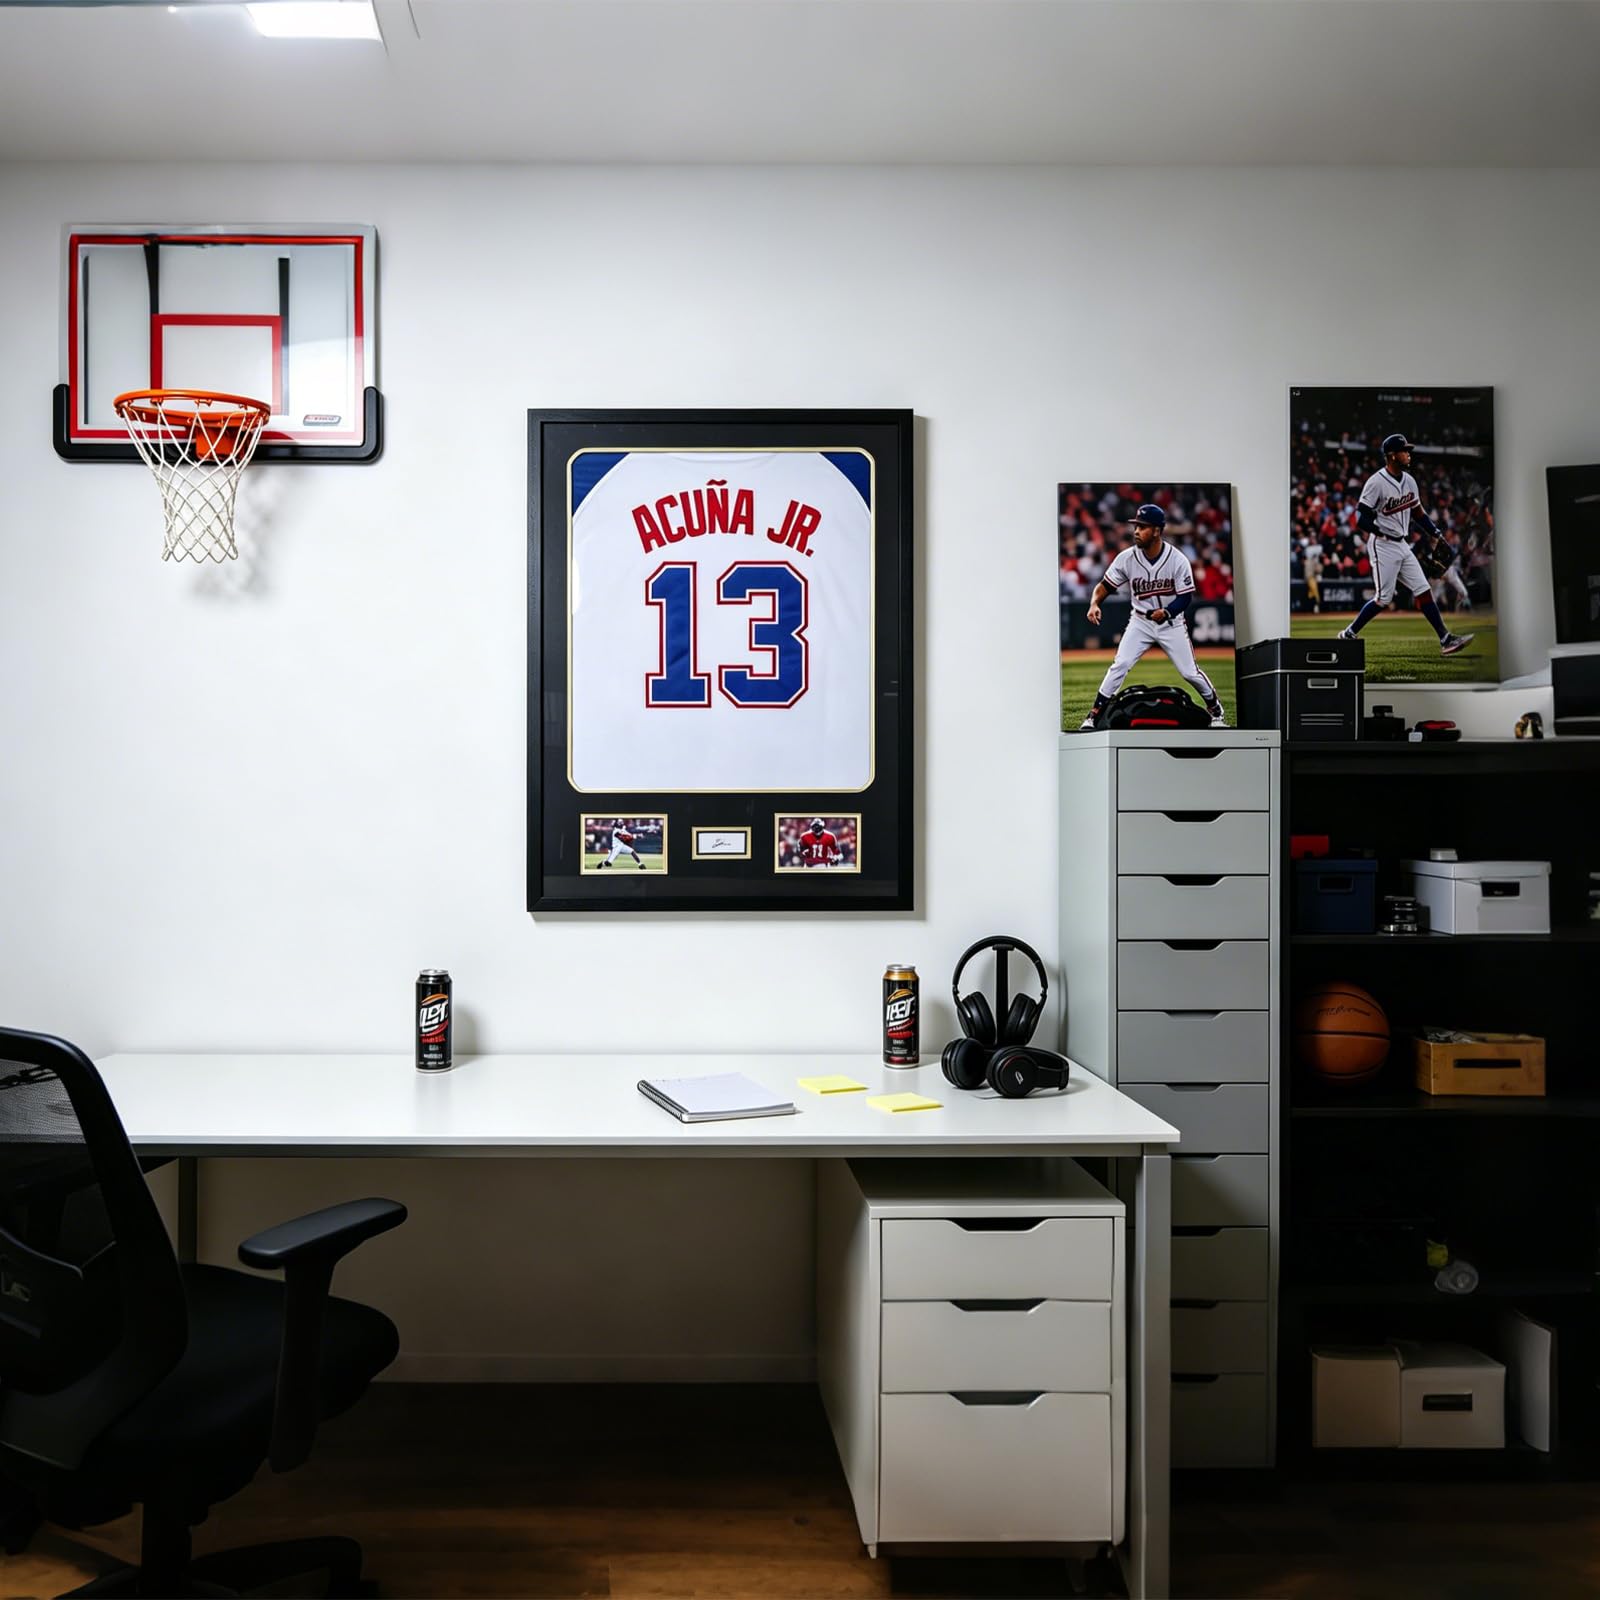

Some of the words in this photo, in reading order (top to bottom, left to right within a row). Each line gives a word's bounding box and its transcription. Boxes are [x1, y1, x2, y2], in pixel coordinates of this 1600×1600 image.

[632, 478, 754, 554] ACUÑA
[766, 500, 822, 557] JR.
[645, 560, 809, 709] 13
